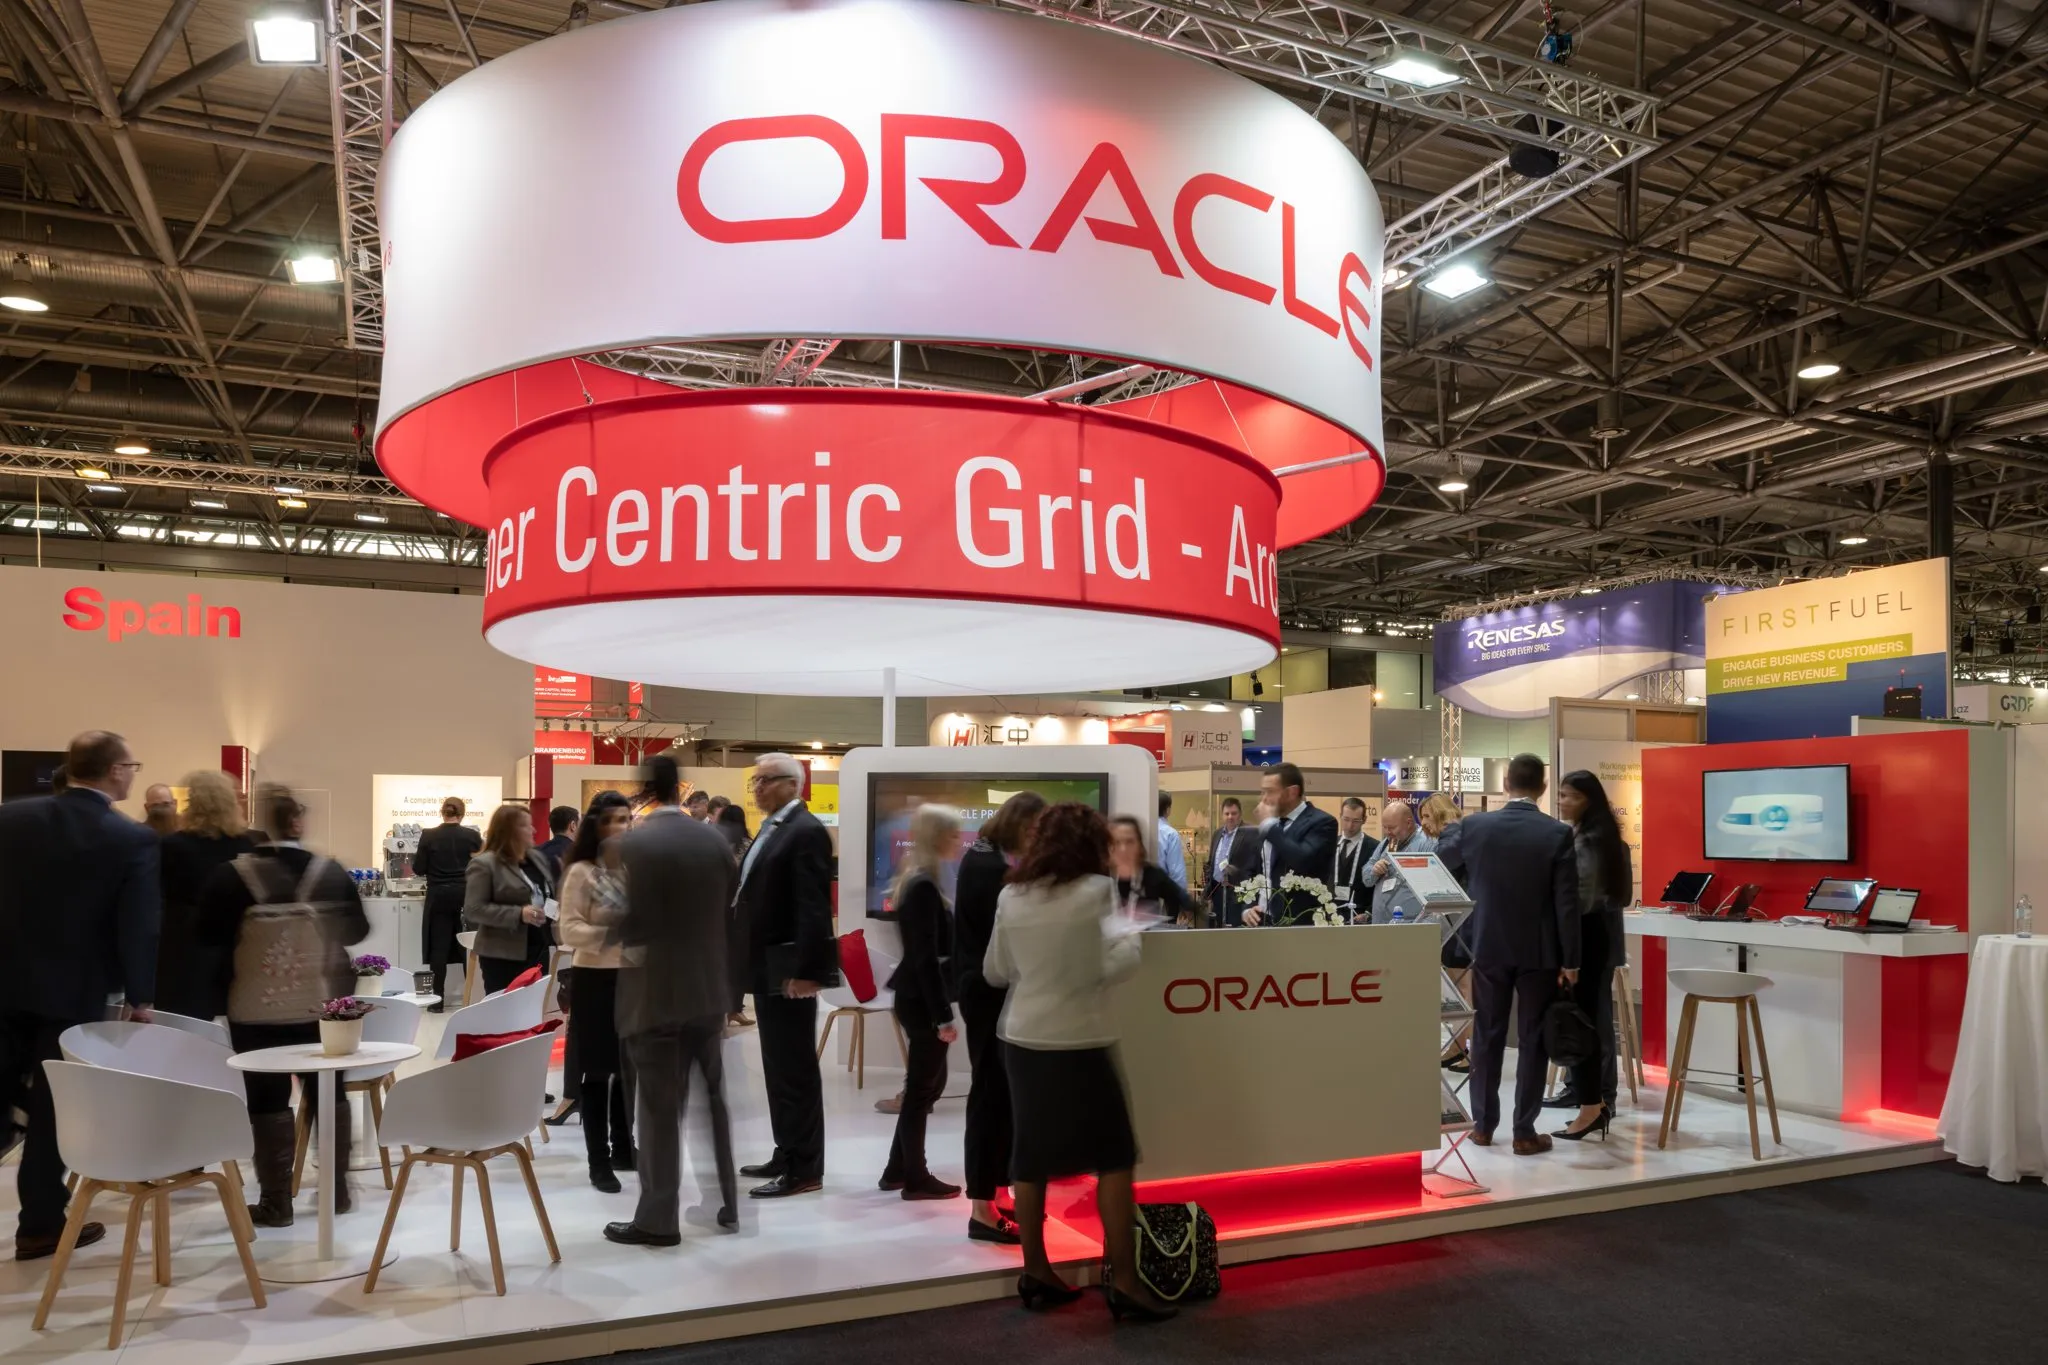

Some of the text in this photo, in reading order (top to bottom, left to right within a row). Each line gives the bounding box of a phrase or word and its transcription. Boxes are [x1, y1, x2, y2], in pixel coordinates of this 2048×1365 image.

[677, 113, 1373, 373] ORACLE
[555, 451, 902, 573] Centric
[955, 456, 1151, 581] Grid
[63, 587, 241, 642] Spain
[1723, 591, 1912, 636] FIRSTFUEL
[1468, 619, 1565, 651] RENESAS
[1481, 642, 1551, 661] BIG IDEAS FOR EVERY SPACE
[1723, 640, 1907, 673] ENGAGE BUSINESS CUSTOMERS.
[1723, 666, 1840, 689] DRIVE NEW REVENUE.
[1409, 772, 1429, 780] DEVICES
[1164, 970, 1383, 1014] ORACLE
